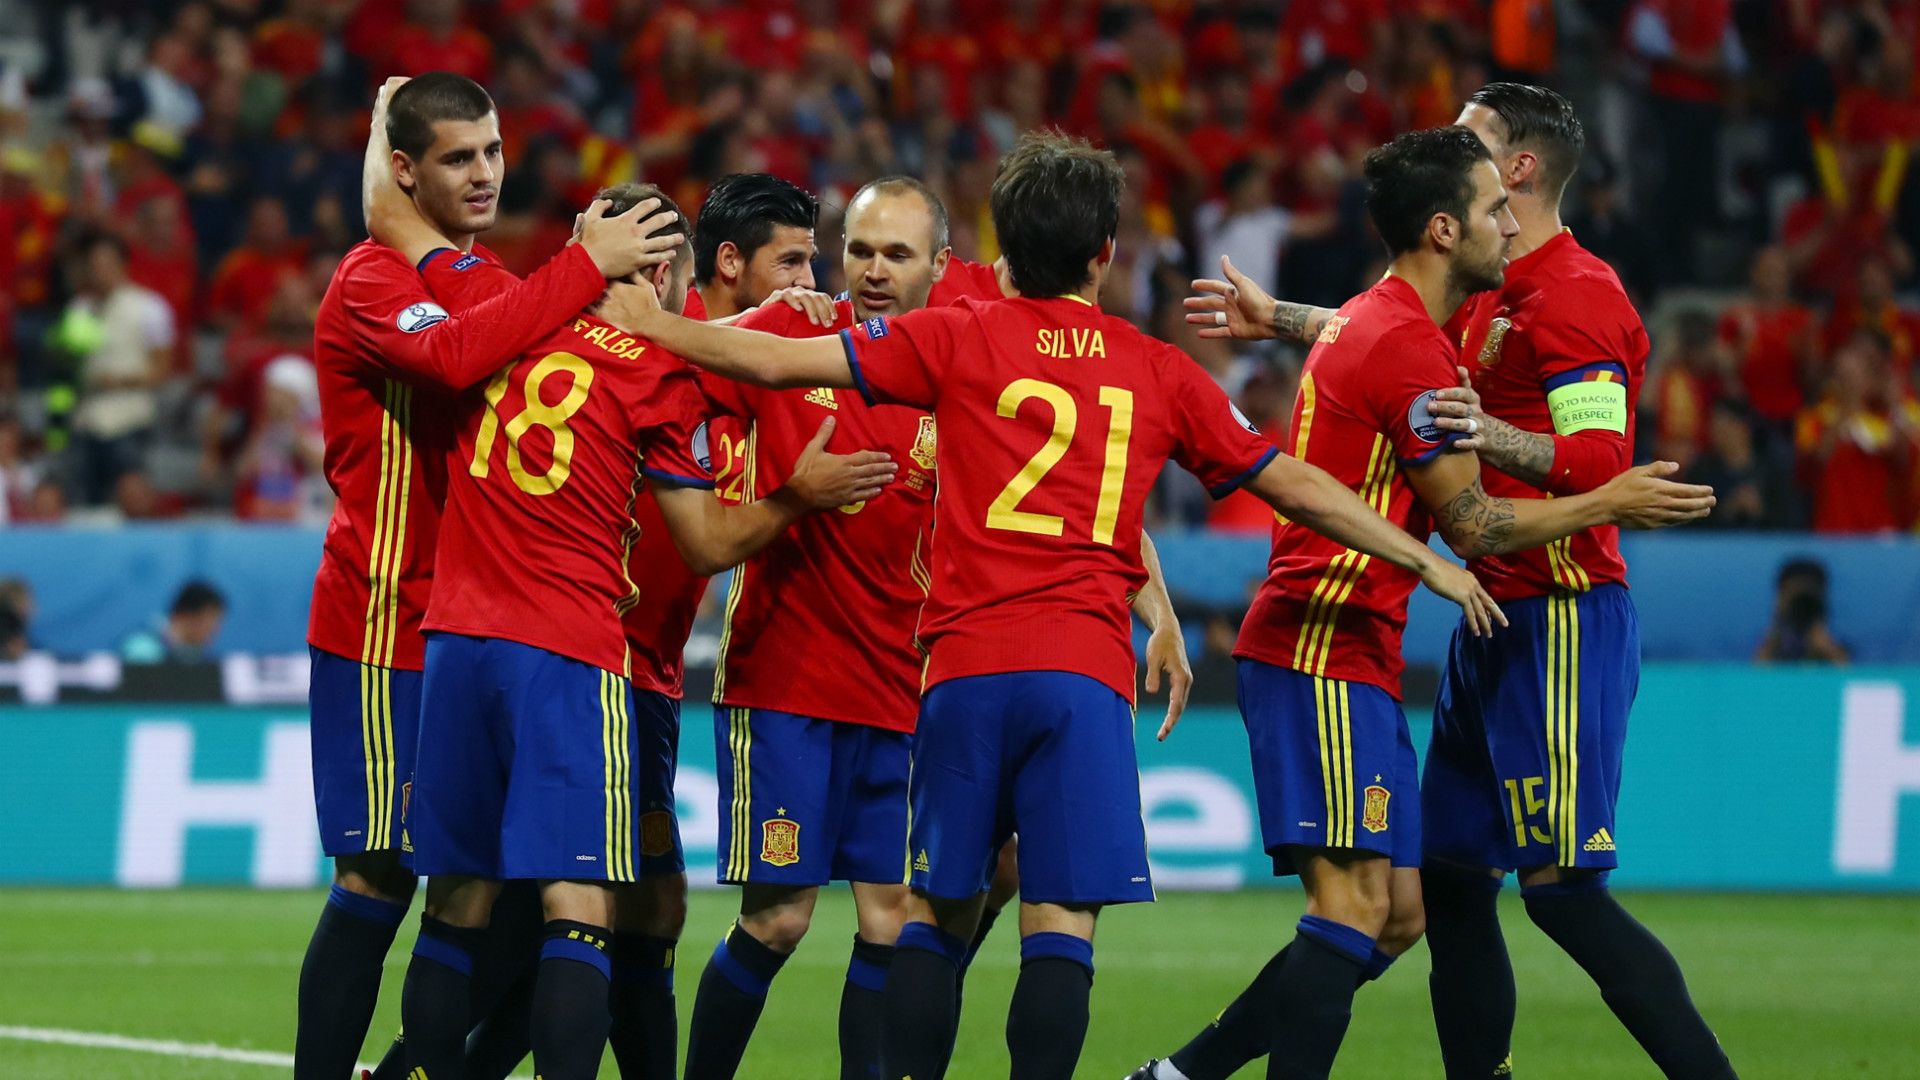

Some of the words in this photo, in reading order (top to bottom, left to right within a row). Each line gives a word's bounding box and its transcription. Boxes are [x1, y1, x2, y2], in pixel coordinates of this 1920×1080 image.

[583, 326, 646, 360] ALBA
[1035, 328, 1106, 358] SILVA
[804, 393, 839, 410] adidas
[1566, 398, 1580, 407] TO
[1581, 395, 1618, 405] RACISM
[1572, 410, 1614, 421] RESPECT
[468, 351, 595, 496] 18
[985, 378, 1134, 546] 21
[1504, 776, 1554, 848] 15
